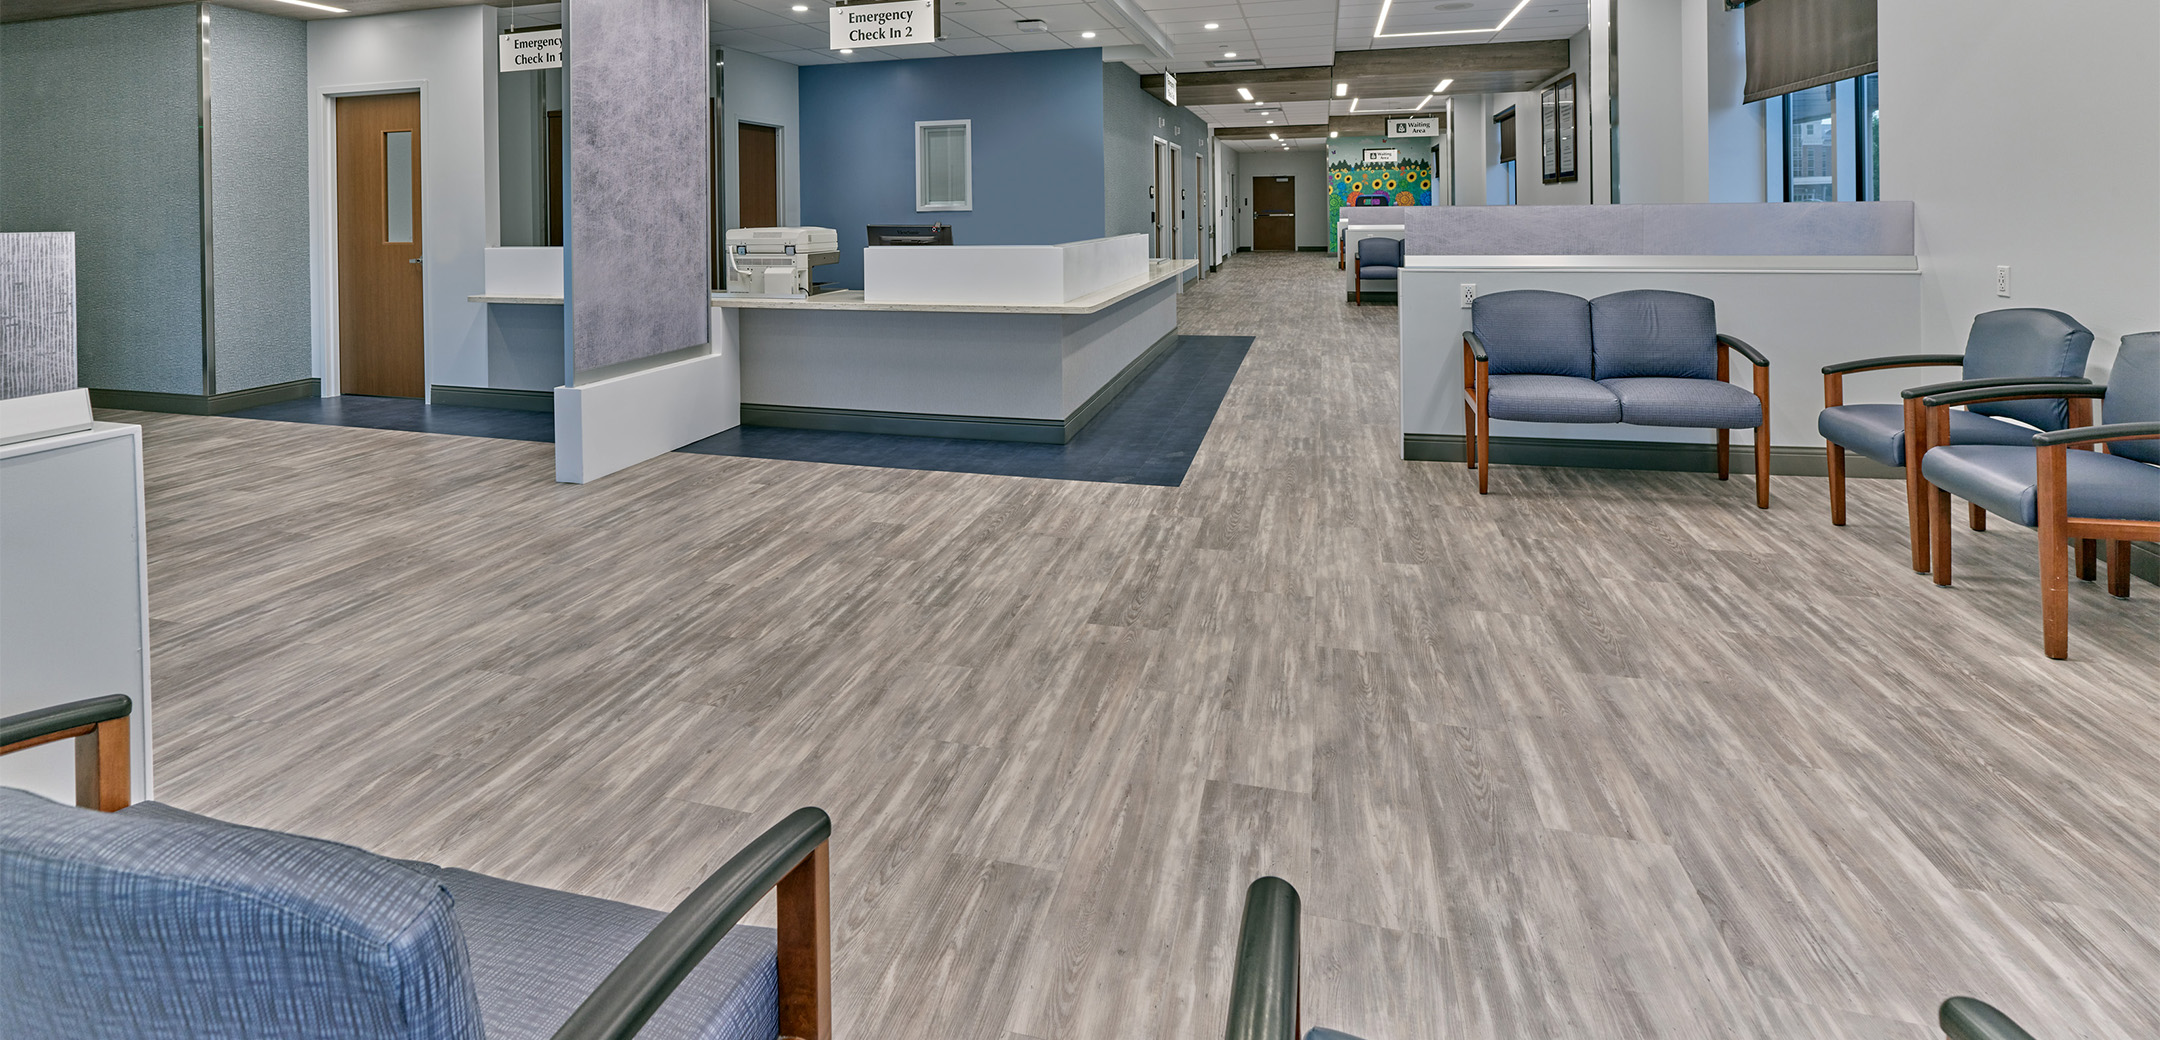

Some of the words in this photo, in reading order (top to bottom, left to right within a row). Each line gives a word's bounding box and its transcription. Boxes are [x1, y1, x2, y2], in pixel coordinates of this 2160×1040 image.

[848, 10, 913, 25] Emergency
[849, 28, 886, 42] Check
[890, 28, 901, 38] In
[905, 26, 913, 37] 2
[514, 37, 562, 50] Emergency
[514, 52, 544, 65] Check
[546, 52, 556, 62] In
